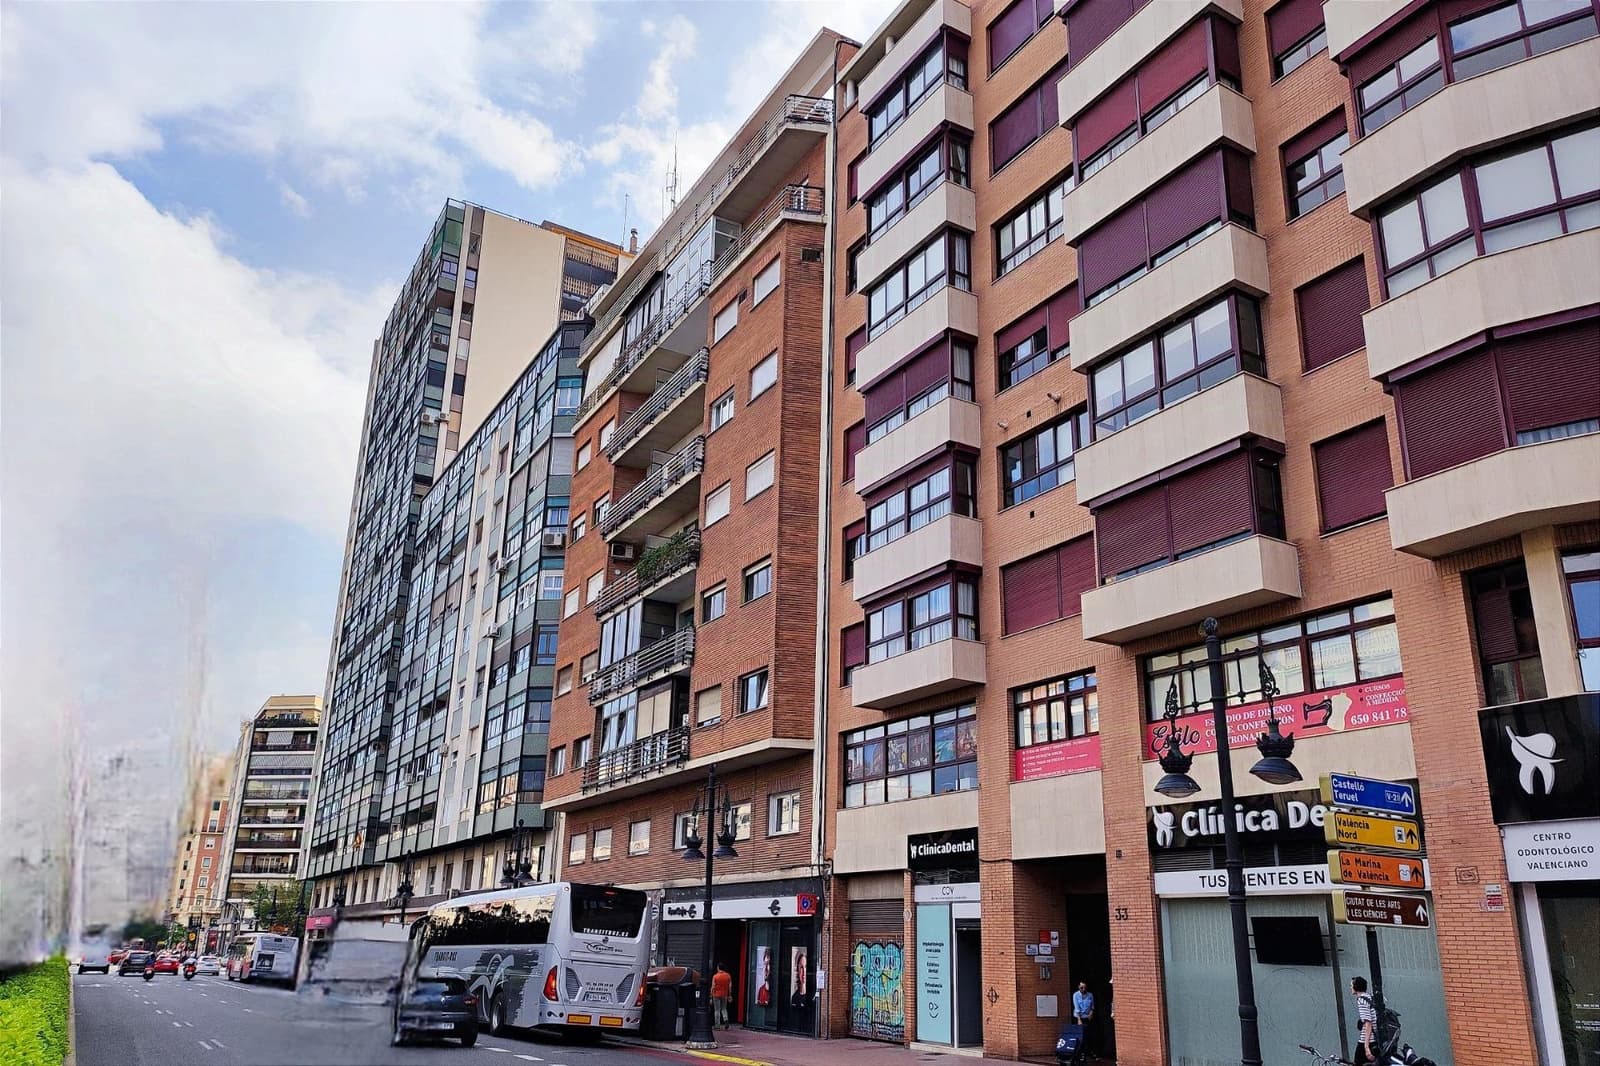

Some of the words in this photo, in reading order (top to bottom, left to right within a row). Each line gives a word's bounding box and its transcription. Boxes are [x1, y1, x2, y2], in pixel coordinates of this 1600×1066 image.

[1243, 710, 1256, 720] DE
[1351, 714, 1369, 725] 650
[1372, 710, 1390, 721] 841
[1333, 778, 1365, 792] Castelló
[1334, 790, 1359, 802] Teruel
[1338, 829, 1358, 840] Nord
[1533, 832, 1572, 842] CENTRO
[1517, 845, 1594, 857] ODONTOLÓGICO
[1341, 856, 1350, 866] La
[1355, 857, 1381, 869] Marina
[1527, 860, 1588, 870] VALENCIANO
[1199, 875, 1227, 888] TUS
[1243, 872, 1298, 886] IENTES
[1304, 870, 1325, 884] EN
[1343, 869, 1352, 878] de
[1366, 898, 1374, 907] DE
[1376, 899, 1386, 908] LES
[1351, 909, 1362, 917] LES
